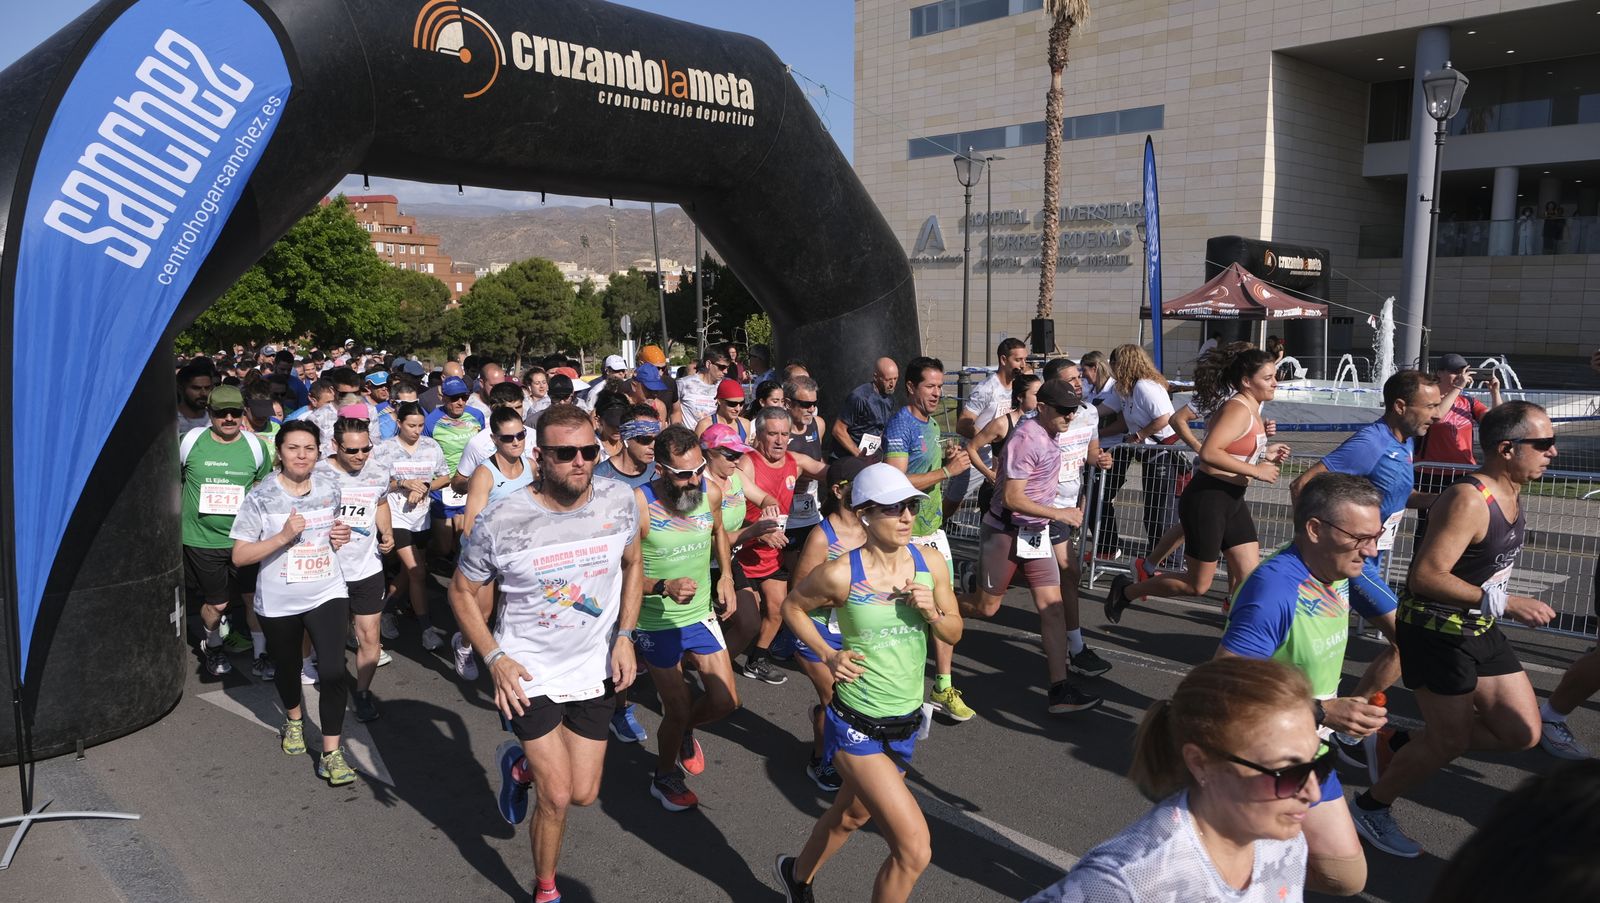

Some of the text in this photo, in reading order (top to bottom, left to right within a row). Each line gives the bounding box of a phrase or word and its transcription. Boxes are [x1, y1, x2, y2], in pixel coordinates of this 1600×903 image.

[598, 90, 754, 127] cronometraje deportivo
[157, 95, 282, 286] centrohogarsanchez.es
[207, 494, 239, 505] 1211
[1029, 535, 1042, 548] 45
[294, 556, 331, 570] 1064
